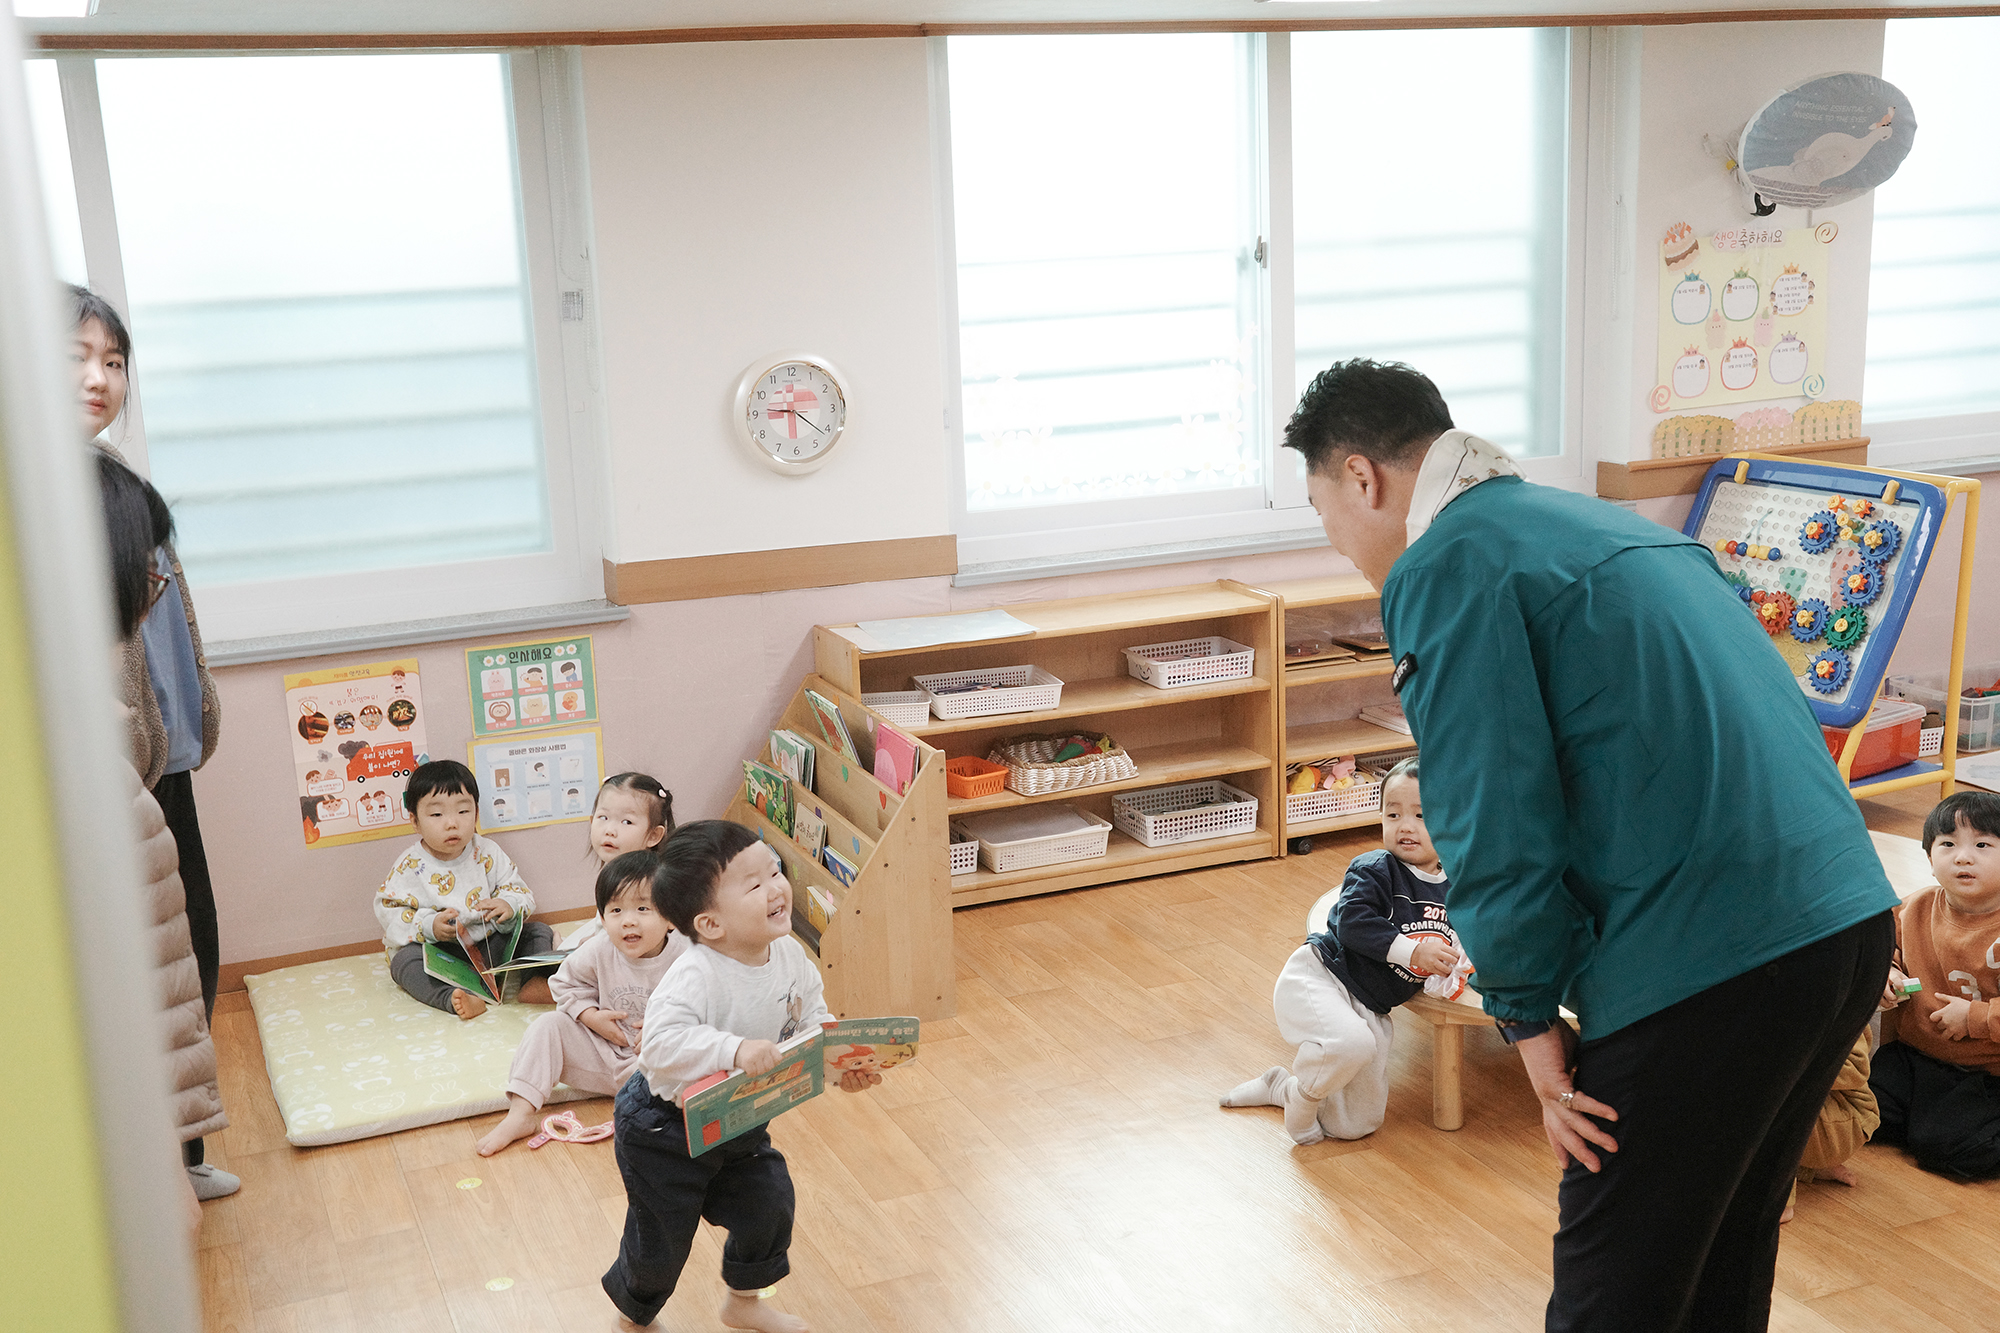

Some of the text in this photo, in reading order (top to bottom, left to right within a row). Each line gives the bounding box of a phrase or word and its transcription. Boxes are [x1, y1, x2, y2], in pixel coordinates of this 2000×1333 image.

[787, 367, 797, 377] 12
[808, 372, 813, 381] 1
[769, 375, 777, 384] 11
[822, 384, 829, 393] 2
[756, 391, 766, 400] 10
[830, 404, 836, 413] 3
[752, 410, 759, 419] 9
[824, 424, 831, 433] 4
[759, 430, 766, 439] 8
[775, 443, 782, 452] 7
[812, 439, 819, 448] 5
[793, 446, 800, 455] 6
[508, 646, 552, 664] 인사해요
[362, 752, 376, 761] 우리
